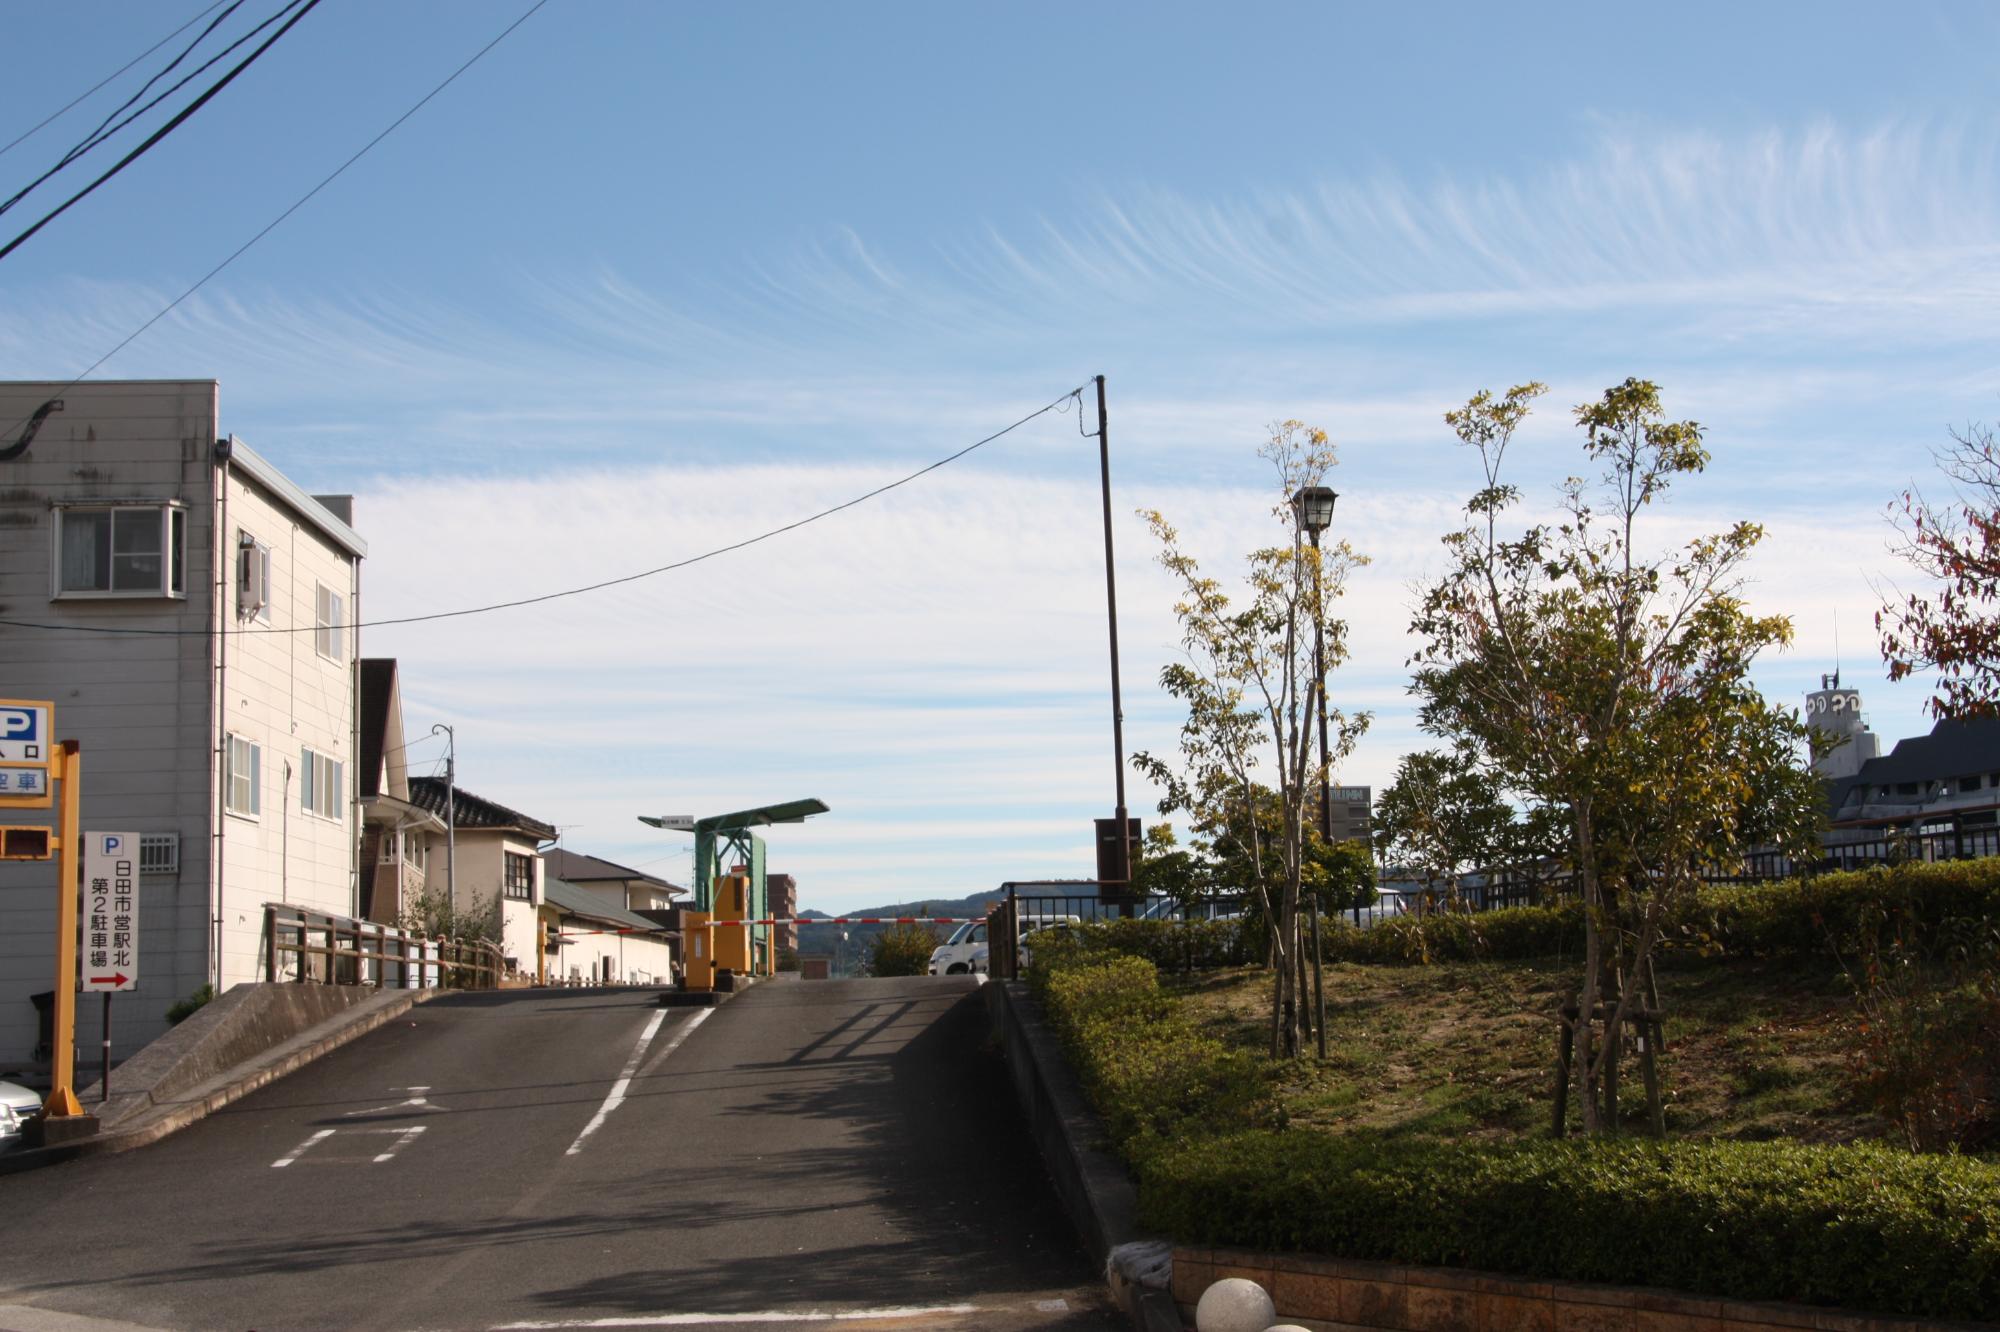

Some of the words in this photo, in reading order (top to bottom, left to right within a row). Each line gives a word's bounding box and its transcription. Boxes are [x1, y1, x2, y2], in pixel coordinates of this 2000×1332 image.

[0, 711, 31, 738] P
[0, 744, 39, 759] 口
[105, 837, 119, 854] P
[90, 877, 109, 968] 第2駐車場
[112, 860, 131, 967] 日田市営駅北
